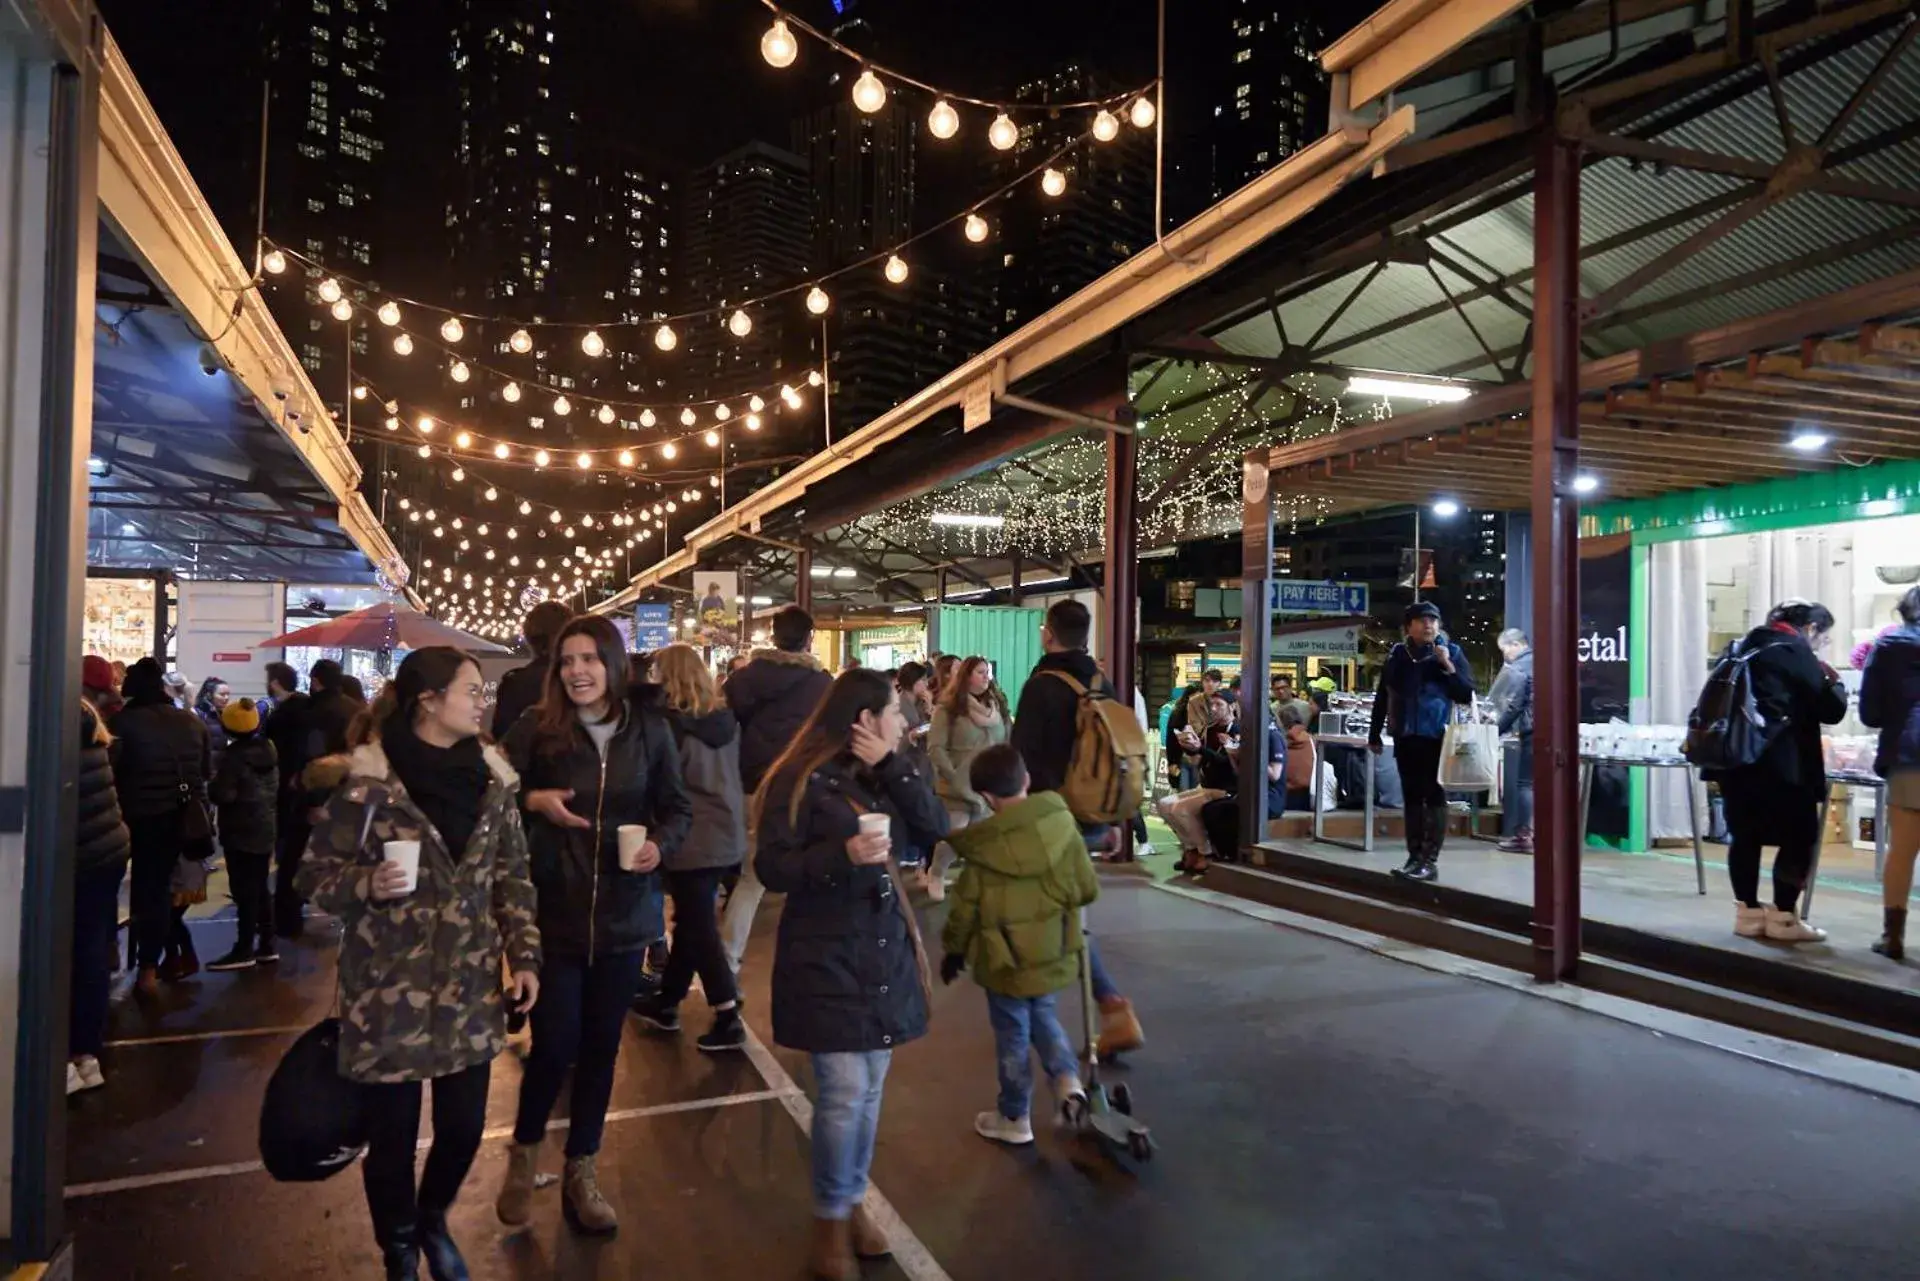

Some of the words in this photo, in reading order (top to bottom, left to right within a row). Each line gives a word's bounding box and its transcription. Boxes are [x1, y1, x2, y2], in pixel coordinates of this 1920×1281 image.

[1283, 586, 1306, 600] PAY
[1309, 586, 1339, 601] HERE
[1288, 641, 1310, 650] JUMP
[1311, 641, 1327, 650] THE
[1328, 642, 1355, 651] QUEUE
[1577, 625, 1628, 662] etal
